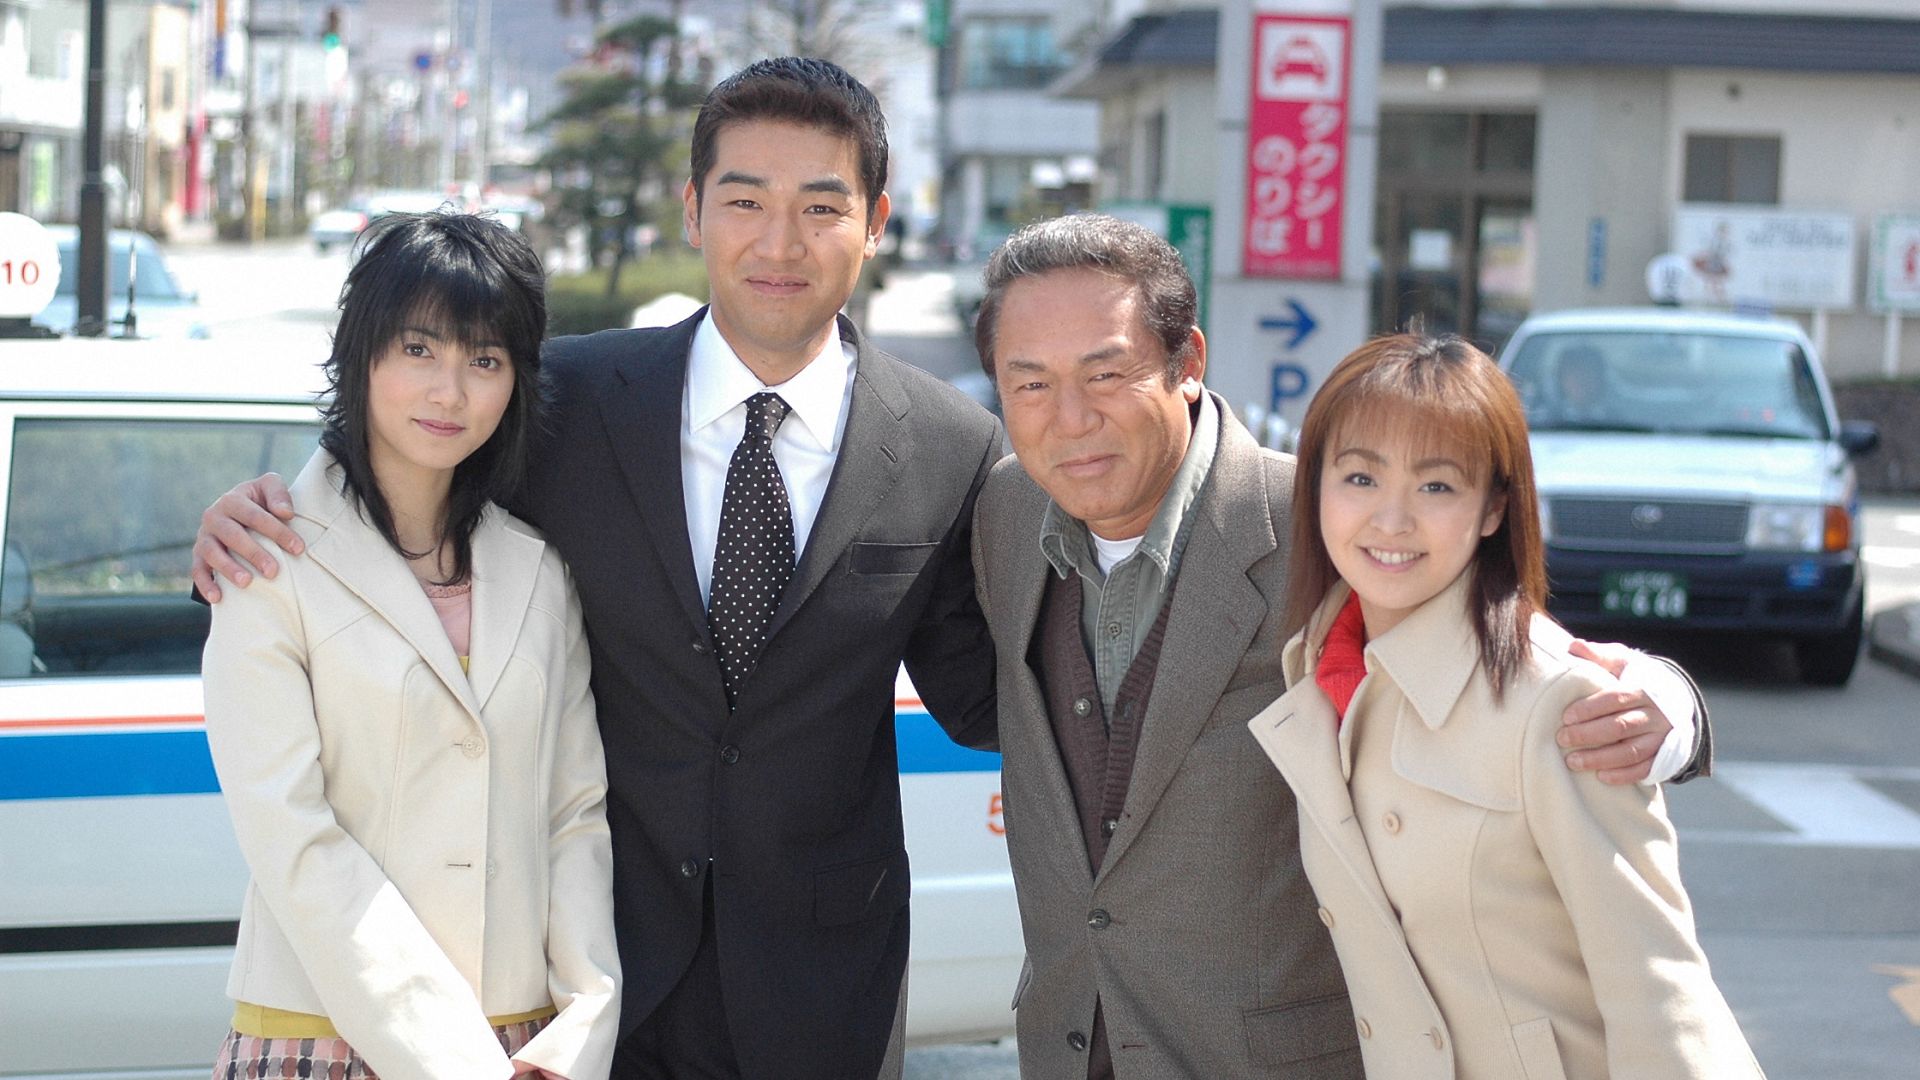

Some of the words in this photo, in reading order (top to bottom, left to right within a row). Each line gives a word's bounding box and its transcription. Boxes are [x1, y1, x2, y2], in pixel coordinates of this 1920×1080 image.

[1252, 134, 1297, 255] のりば
[1298, 102, 1341, 248] タクシー
[1, 259, 40, 285] 10
[1270, 361, 1309, 412] P
